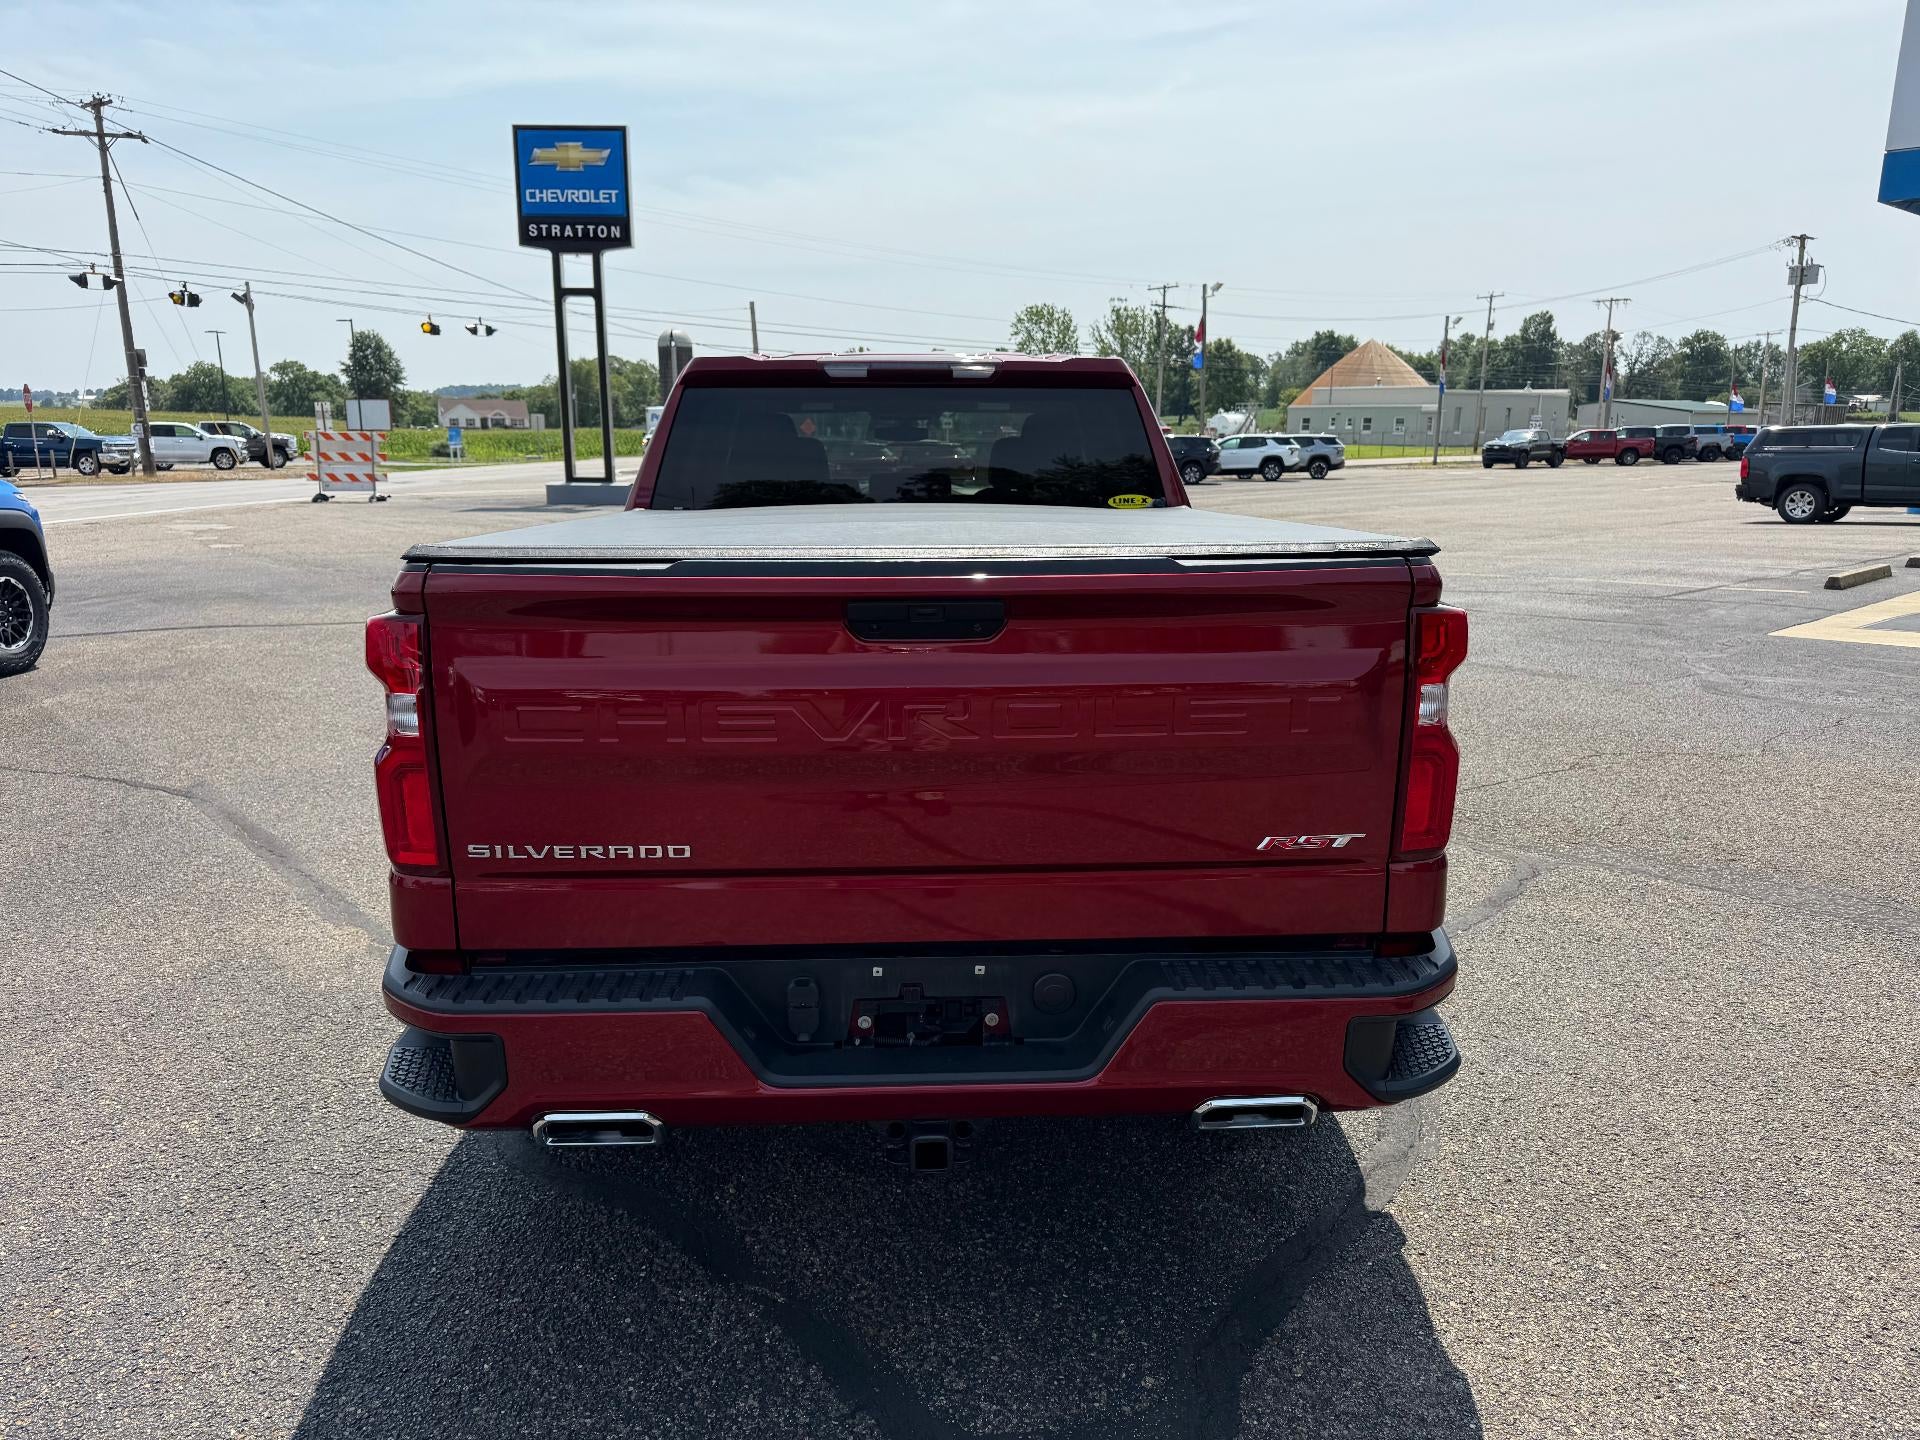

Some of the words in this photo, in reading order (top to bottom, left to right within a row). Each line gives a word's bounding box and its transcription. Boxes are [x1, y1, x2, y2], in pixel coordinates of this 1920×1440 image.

[525, 188, 619, 203] CHEVROLET
[528, 223, 621, 238] STRATTON
[502, 697, 1344, 743] CHEVROLET
[1256, 833, 1367, 850] RST
[467, 844, 692, 859] SILVERADO
